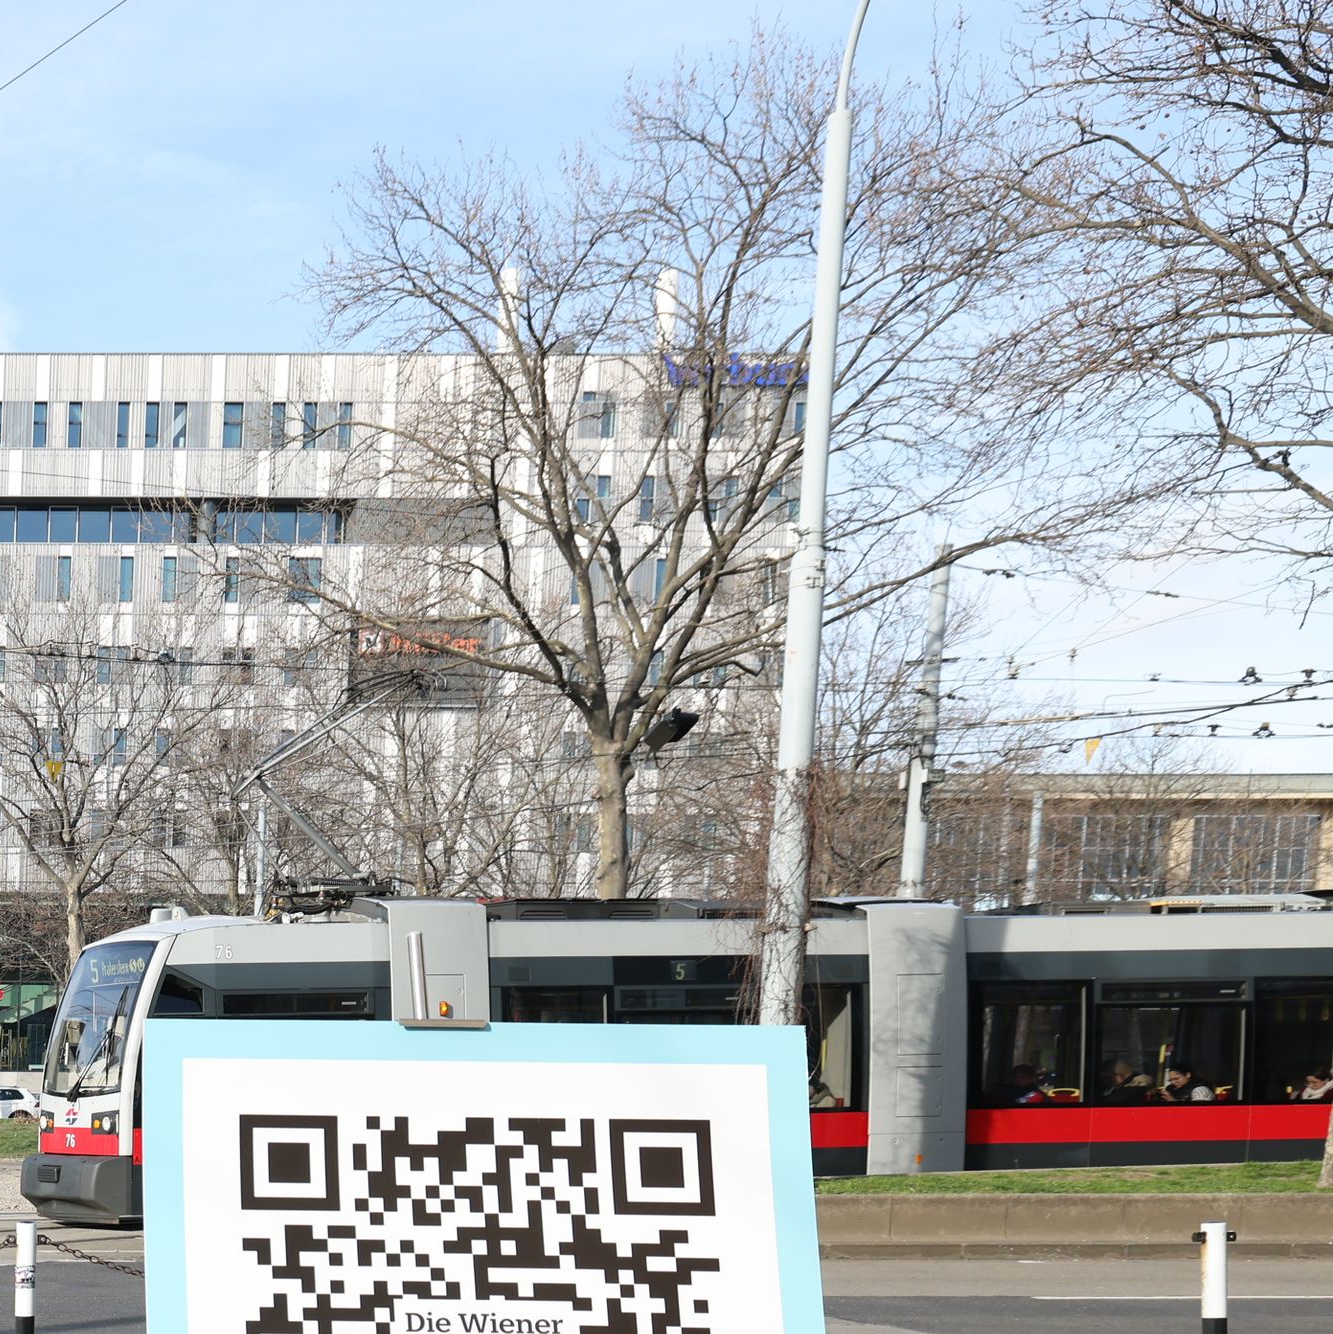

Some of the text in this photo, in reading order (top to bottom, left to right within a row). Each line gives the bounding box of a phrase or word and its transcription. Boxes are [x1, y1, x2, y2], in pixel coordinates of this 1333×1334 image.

[215, 945, 233, 959] 76
[90, 959, 99, 984] 5
[676, 963, 686, 980] 5
[65, 1133, 76, 1148] 76
[405, 1312, 564, 1334] Die Wiener
